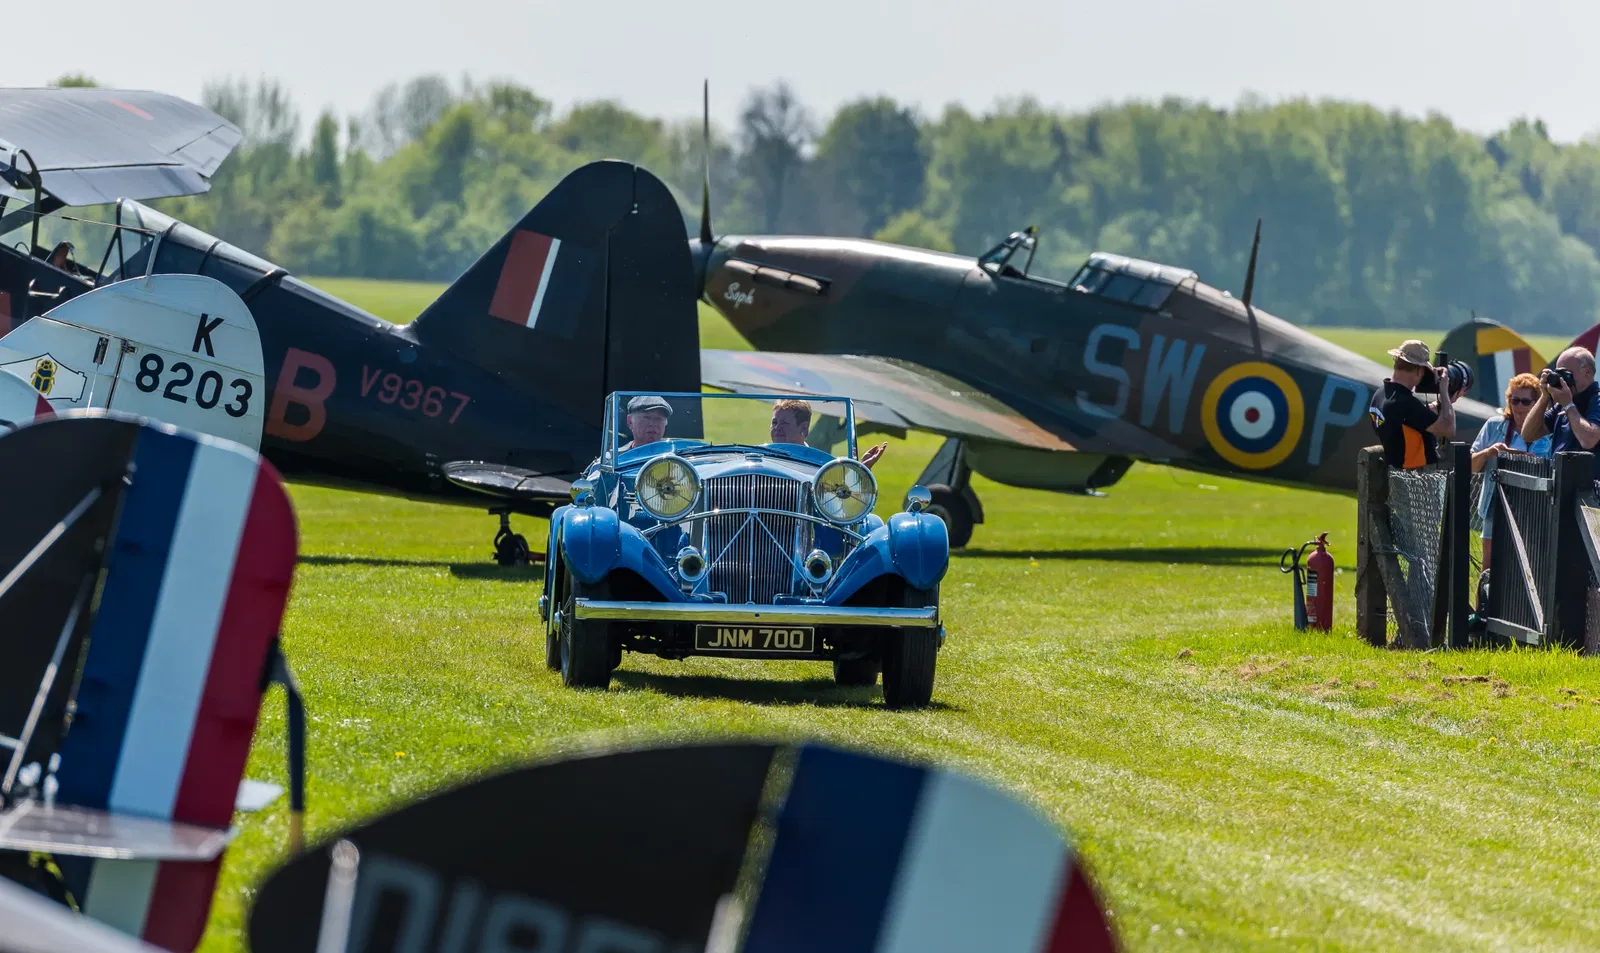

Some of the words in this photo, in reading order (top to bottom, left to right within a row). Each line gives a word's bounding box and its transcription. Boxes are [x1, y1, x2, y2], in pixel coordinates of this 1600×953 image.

[192, 313, 224, 357] K
[135, 353, 253, 418] 8203
[266, 348, 337, 442] B
[359, 365, 470, 425] V9367
[1076, 323, 1208, 434] SW
[1307, 374, 1369, 465] P
[708, 628, 753, 648] JNM
[759, 629, 804, 649] 700
